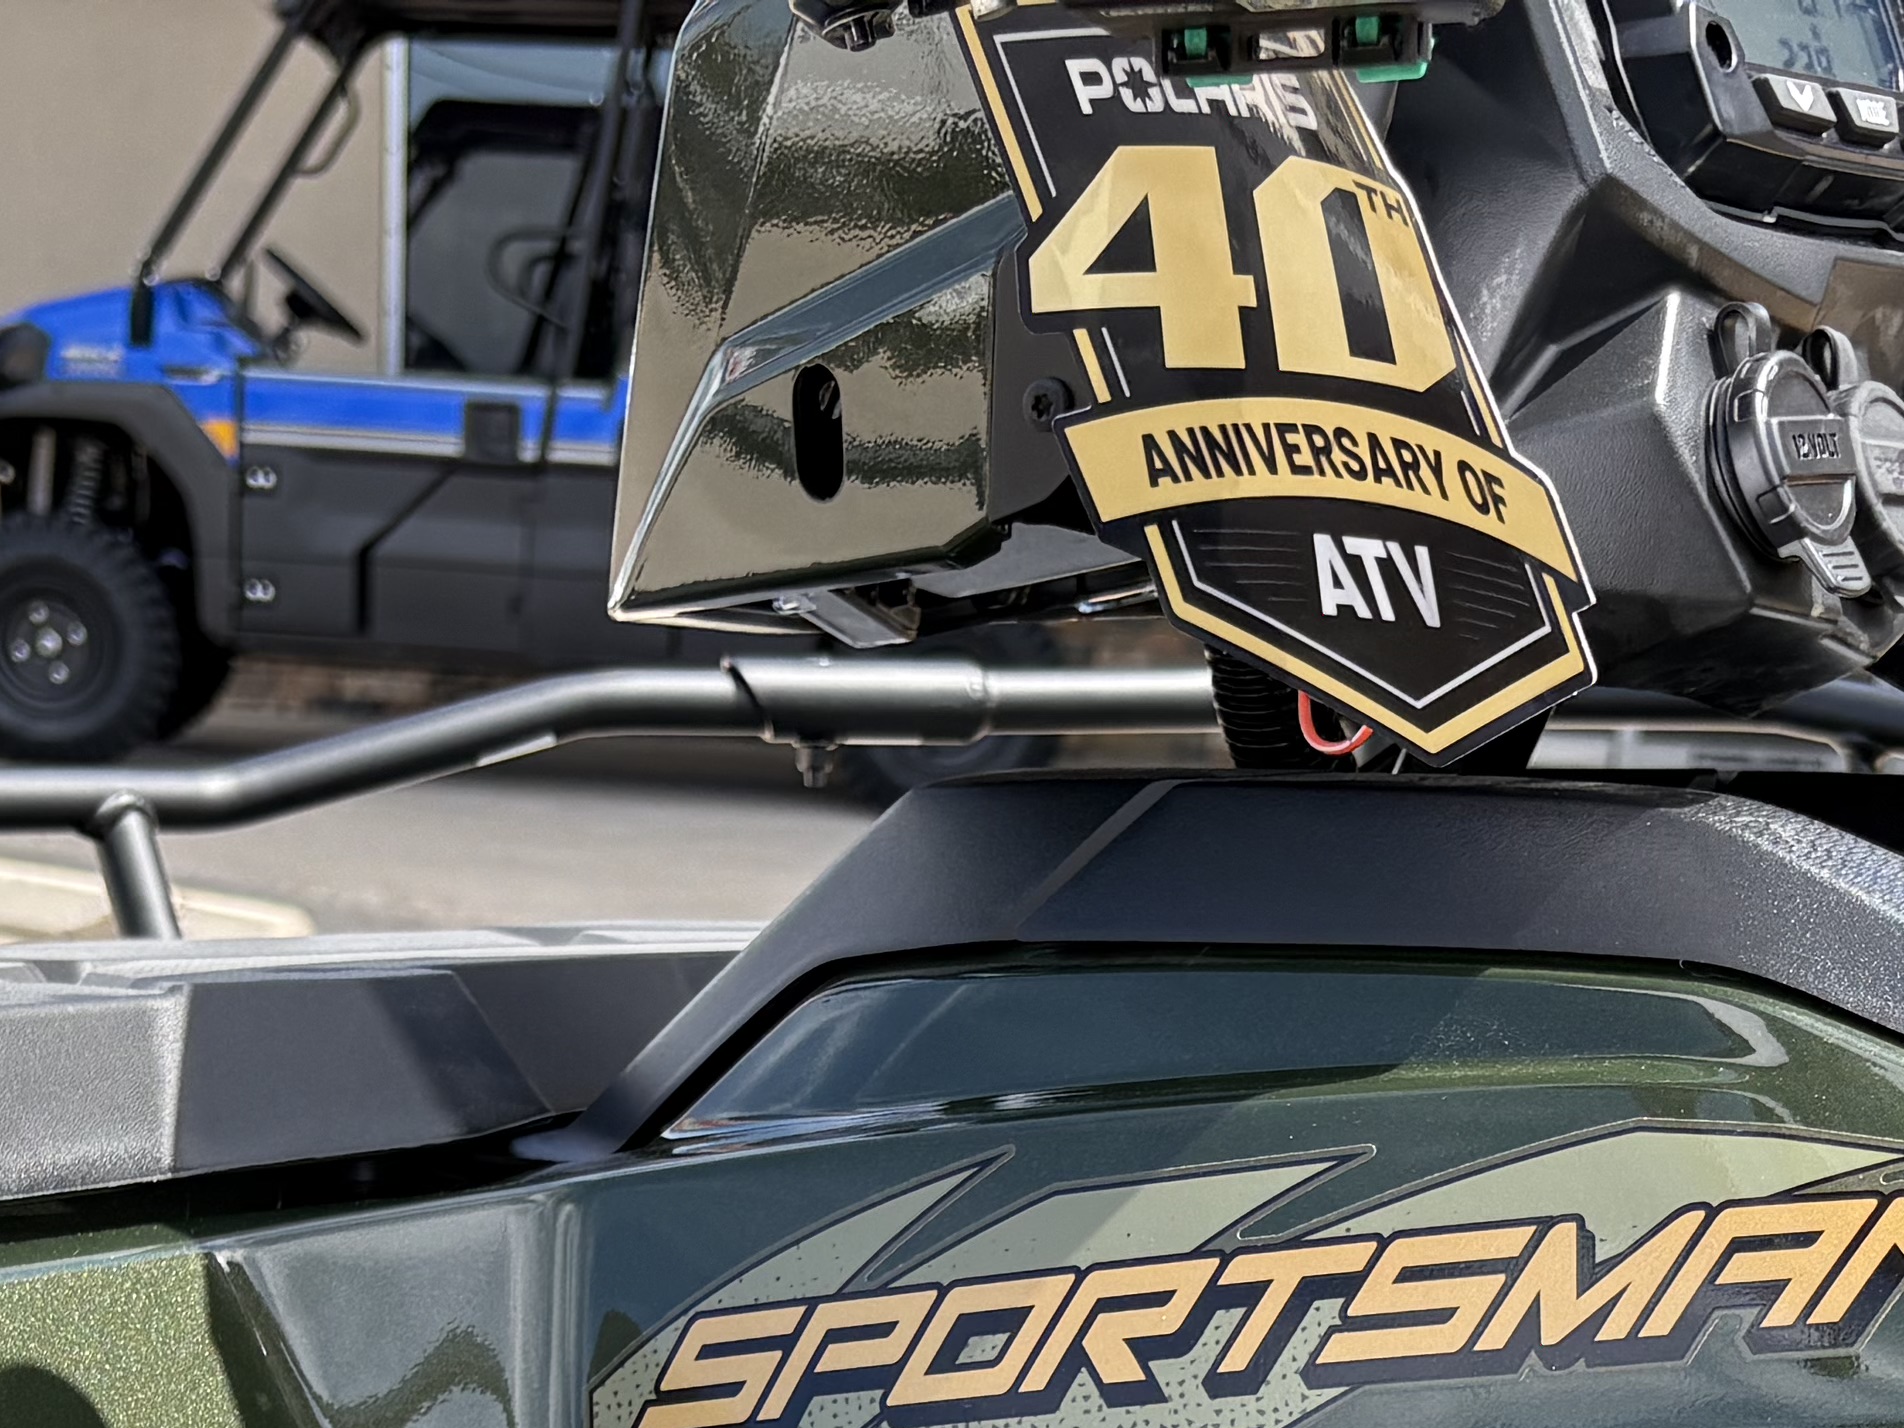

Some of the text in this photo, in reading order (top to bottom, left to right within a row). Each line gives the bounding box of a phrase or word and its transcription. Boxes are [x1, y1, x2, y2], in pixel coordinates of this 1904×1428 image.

[1140, 421, 1508, 525] ANNIVERSARY OF
[1312, 532, 1442, 629] ATV
